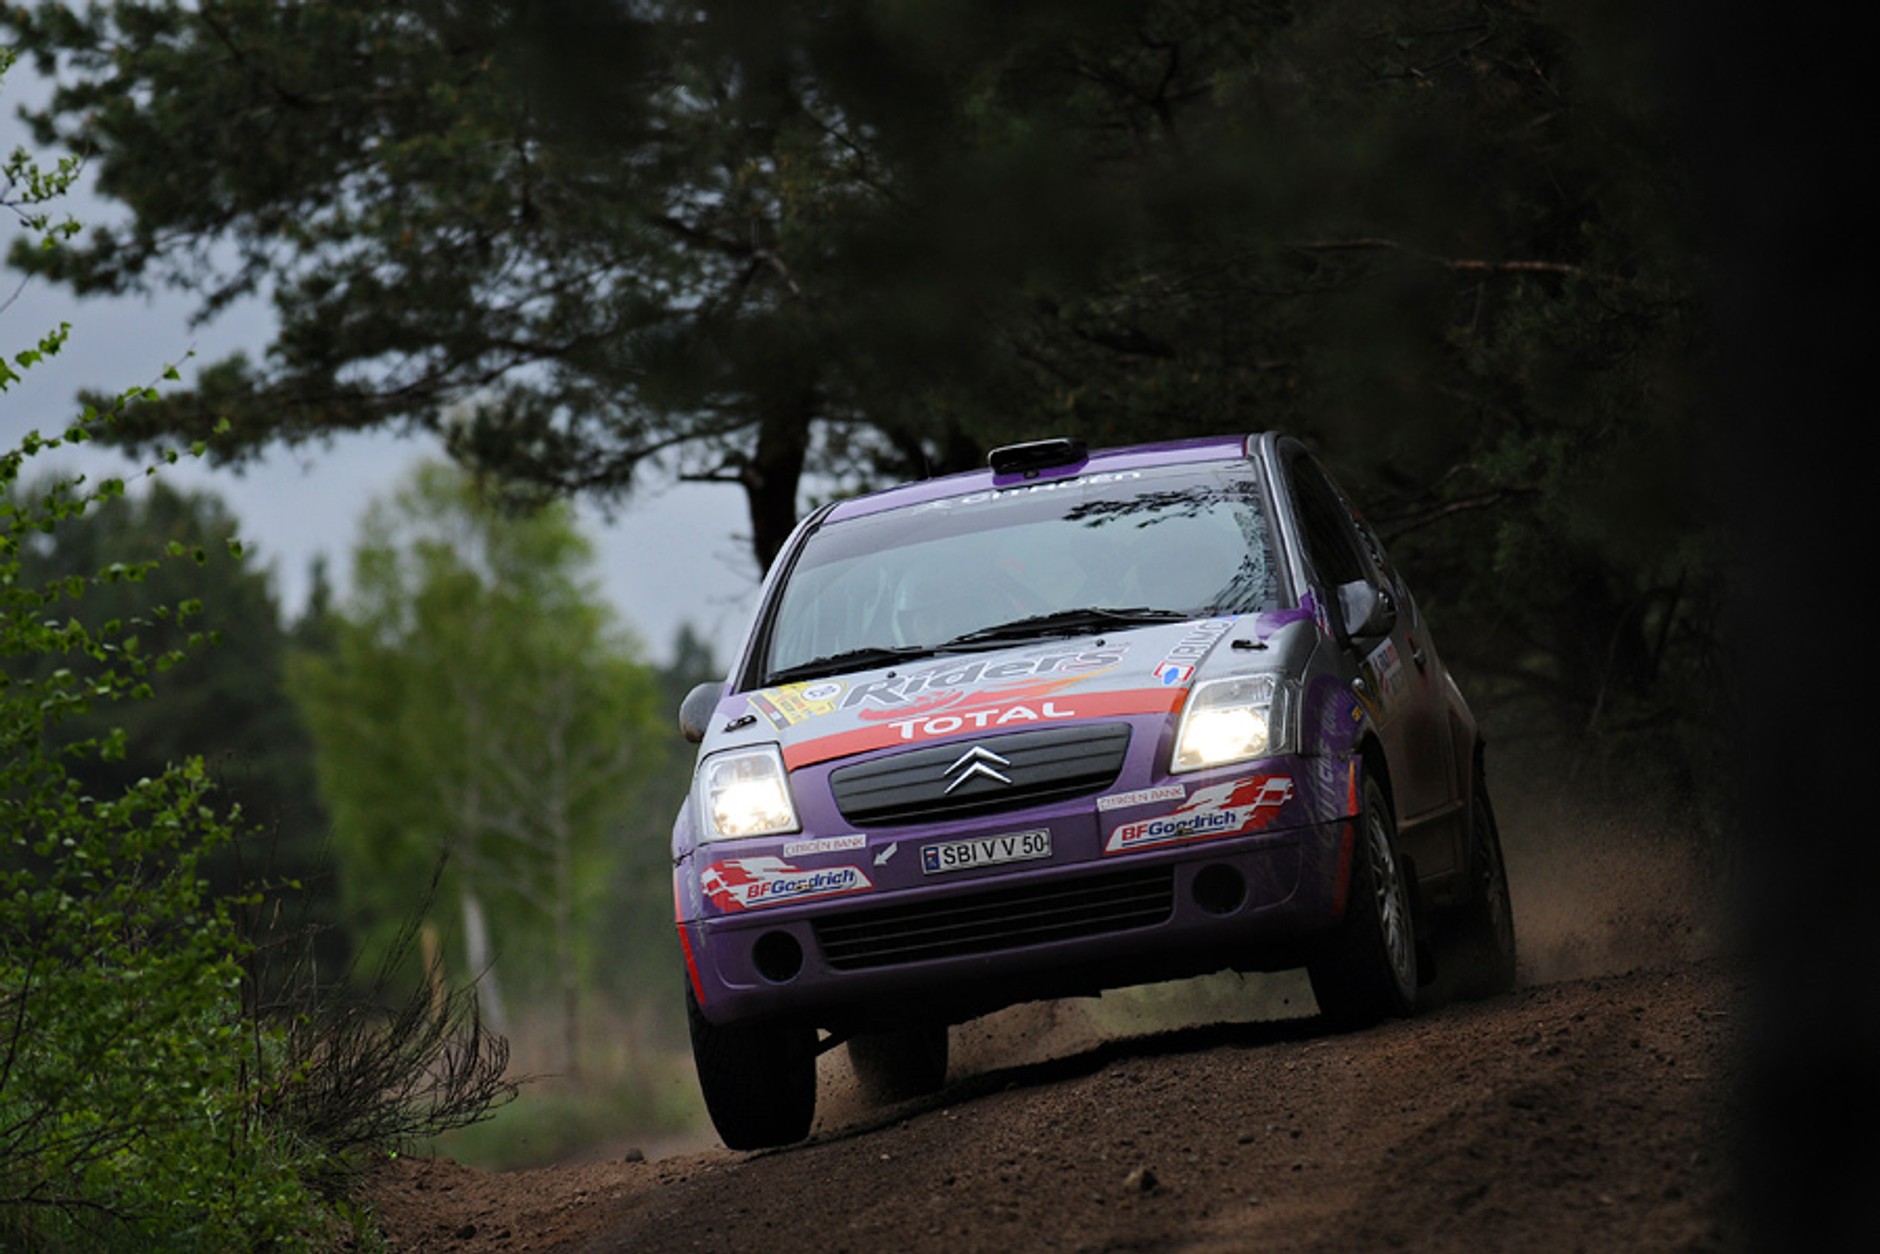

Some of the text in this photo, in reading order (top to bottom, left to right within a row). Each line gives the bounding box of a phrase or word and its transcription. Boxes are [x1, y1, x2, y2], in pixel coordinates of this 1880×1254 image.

[839, 648, 1129, 711] Riders
[889, 702, 1075, 739] TOTAL
[1151, 787, 1182, 801] BANK
[833, 836, 864, 849] BANK
[1023, 834, 1044, 854] 50
